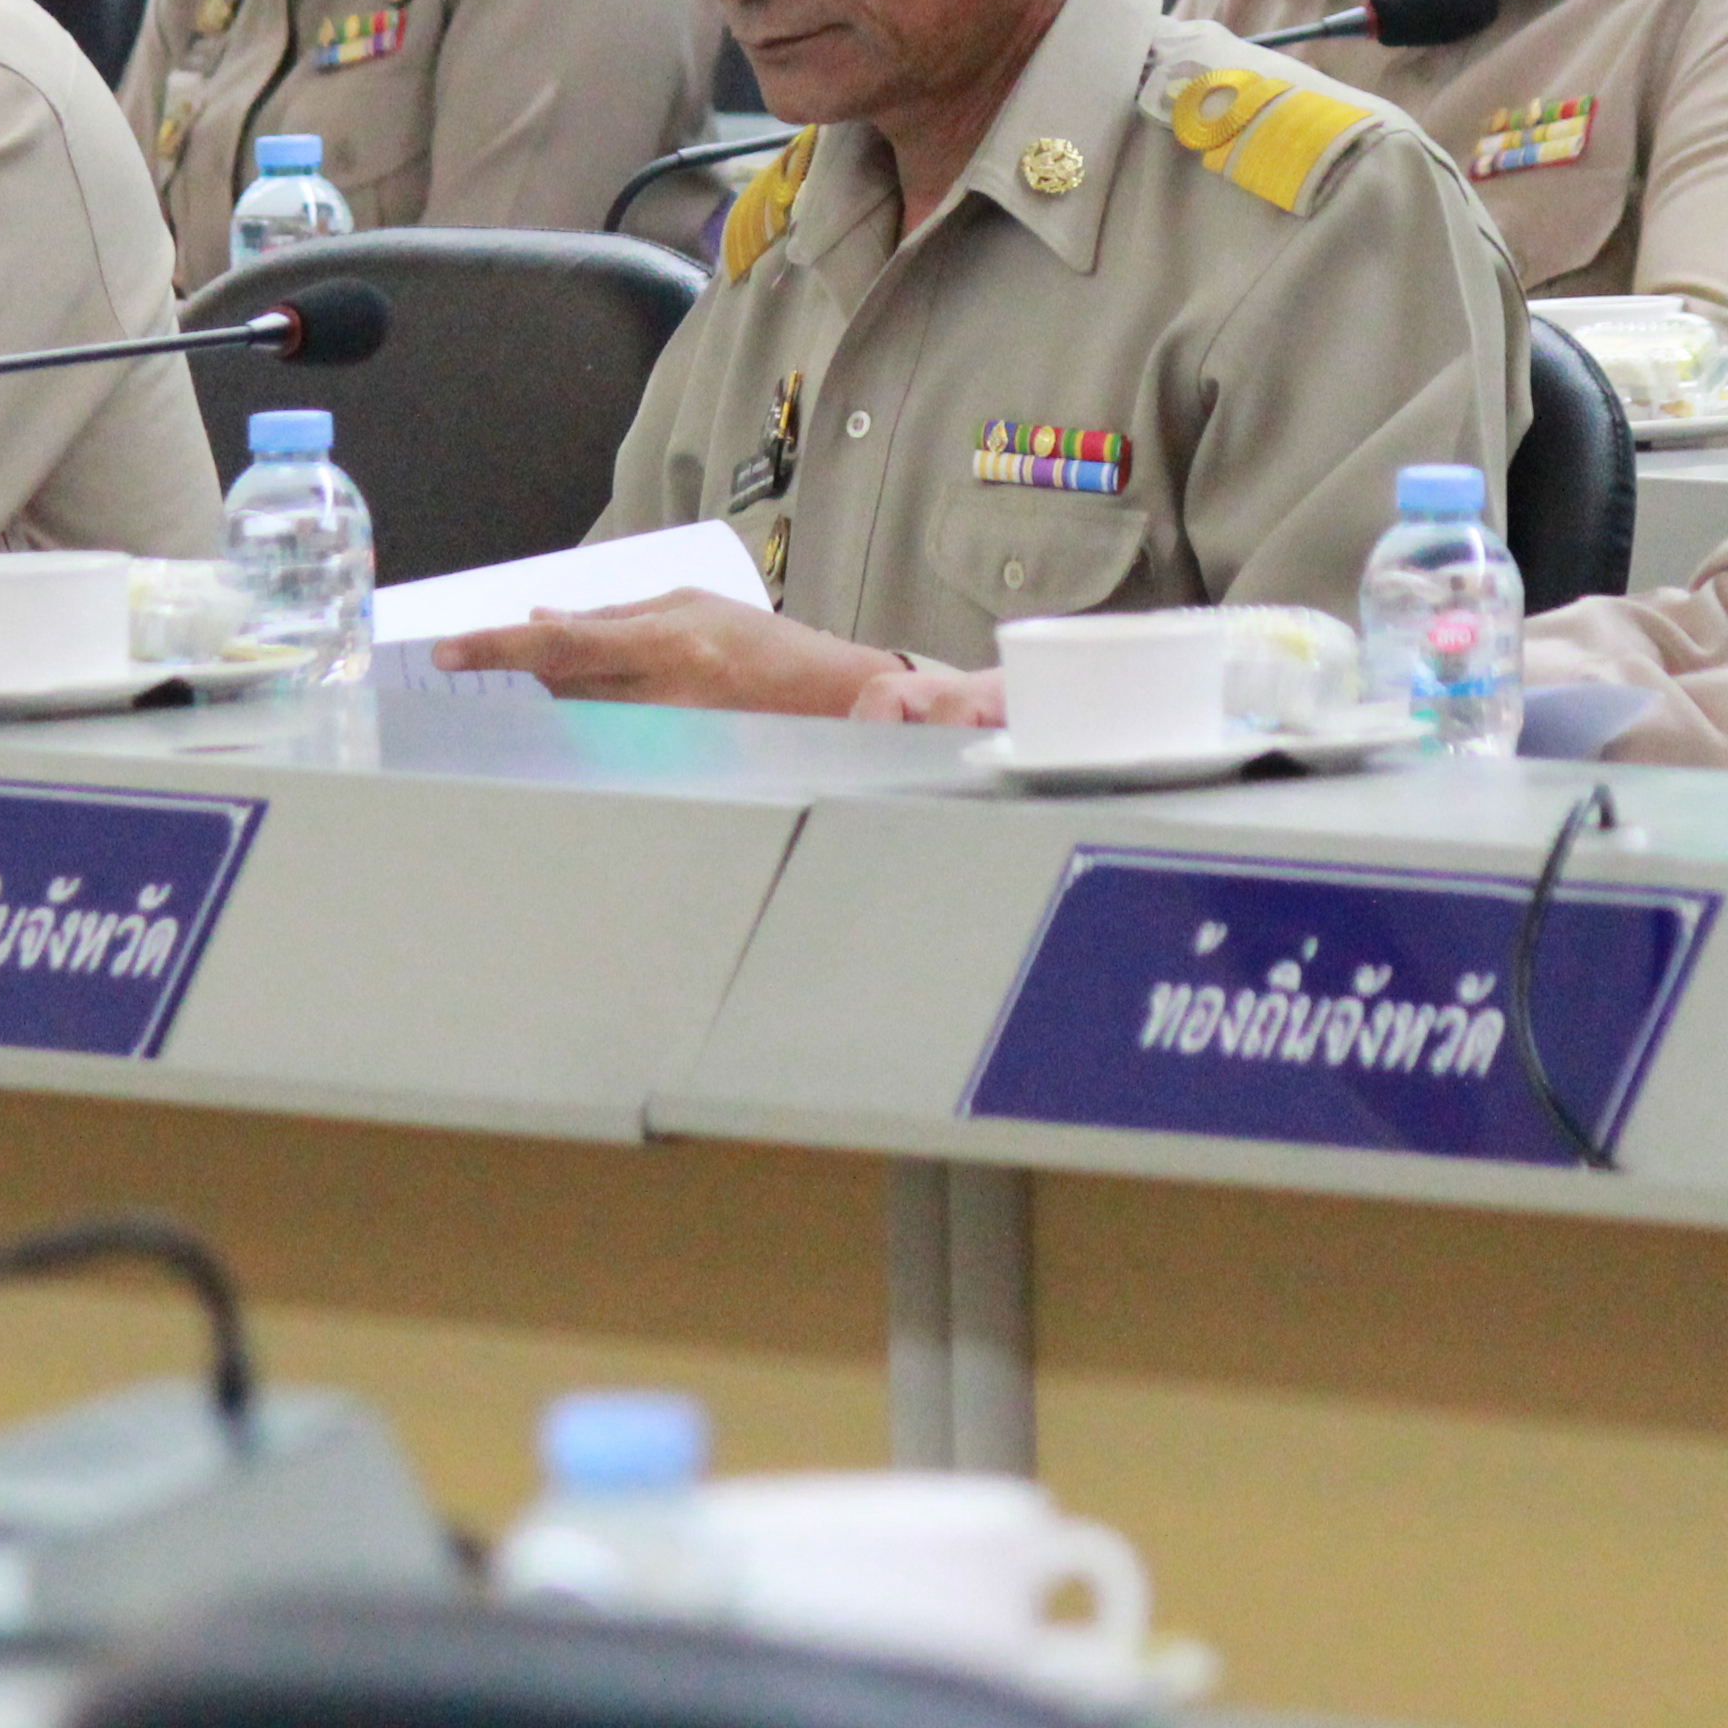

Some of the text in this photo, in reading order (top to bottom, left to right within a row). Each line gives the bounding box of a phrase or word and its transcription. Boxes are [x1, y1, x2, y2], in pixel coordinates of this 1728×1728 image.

[1139, 919, 1507, 1078] ท้องถิ่นจังหวัด
